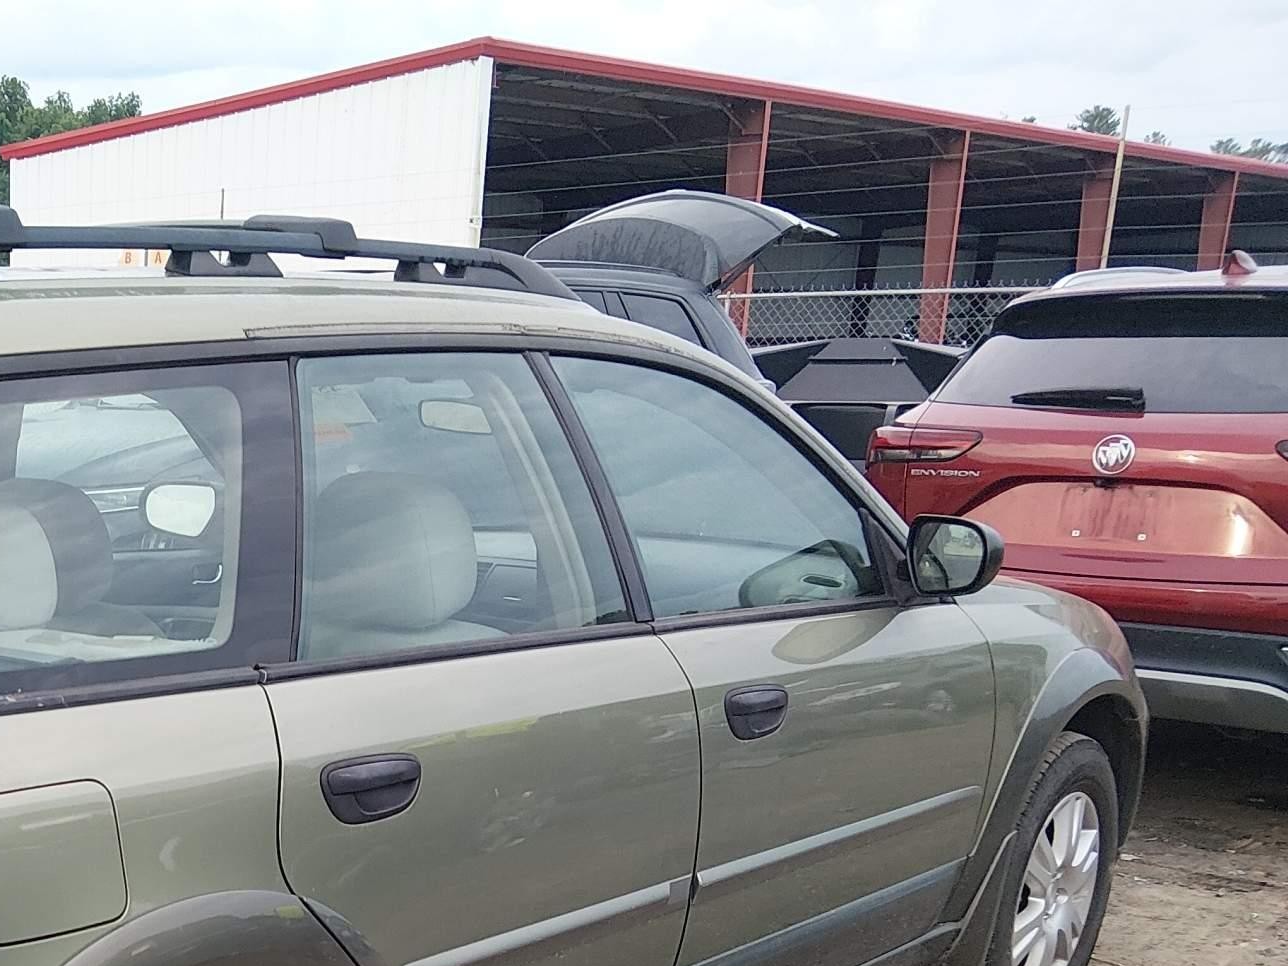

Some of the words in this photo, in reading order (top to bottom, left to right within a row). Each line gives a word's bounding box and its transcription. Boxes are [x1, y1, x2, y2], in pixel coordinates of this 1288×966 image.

[124, 251, 132, 265] B
[154, 251, 162, 265] A
[910, 468, 981, 478] ENVISION
